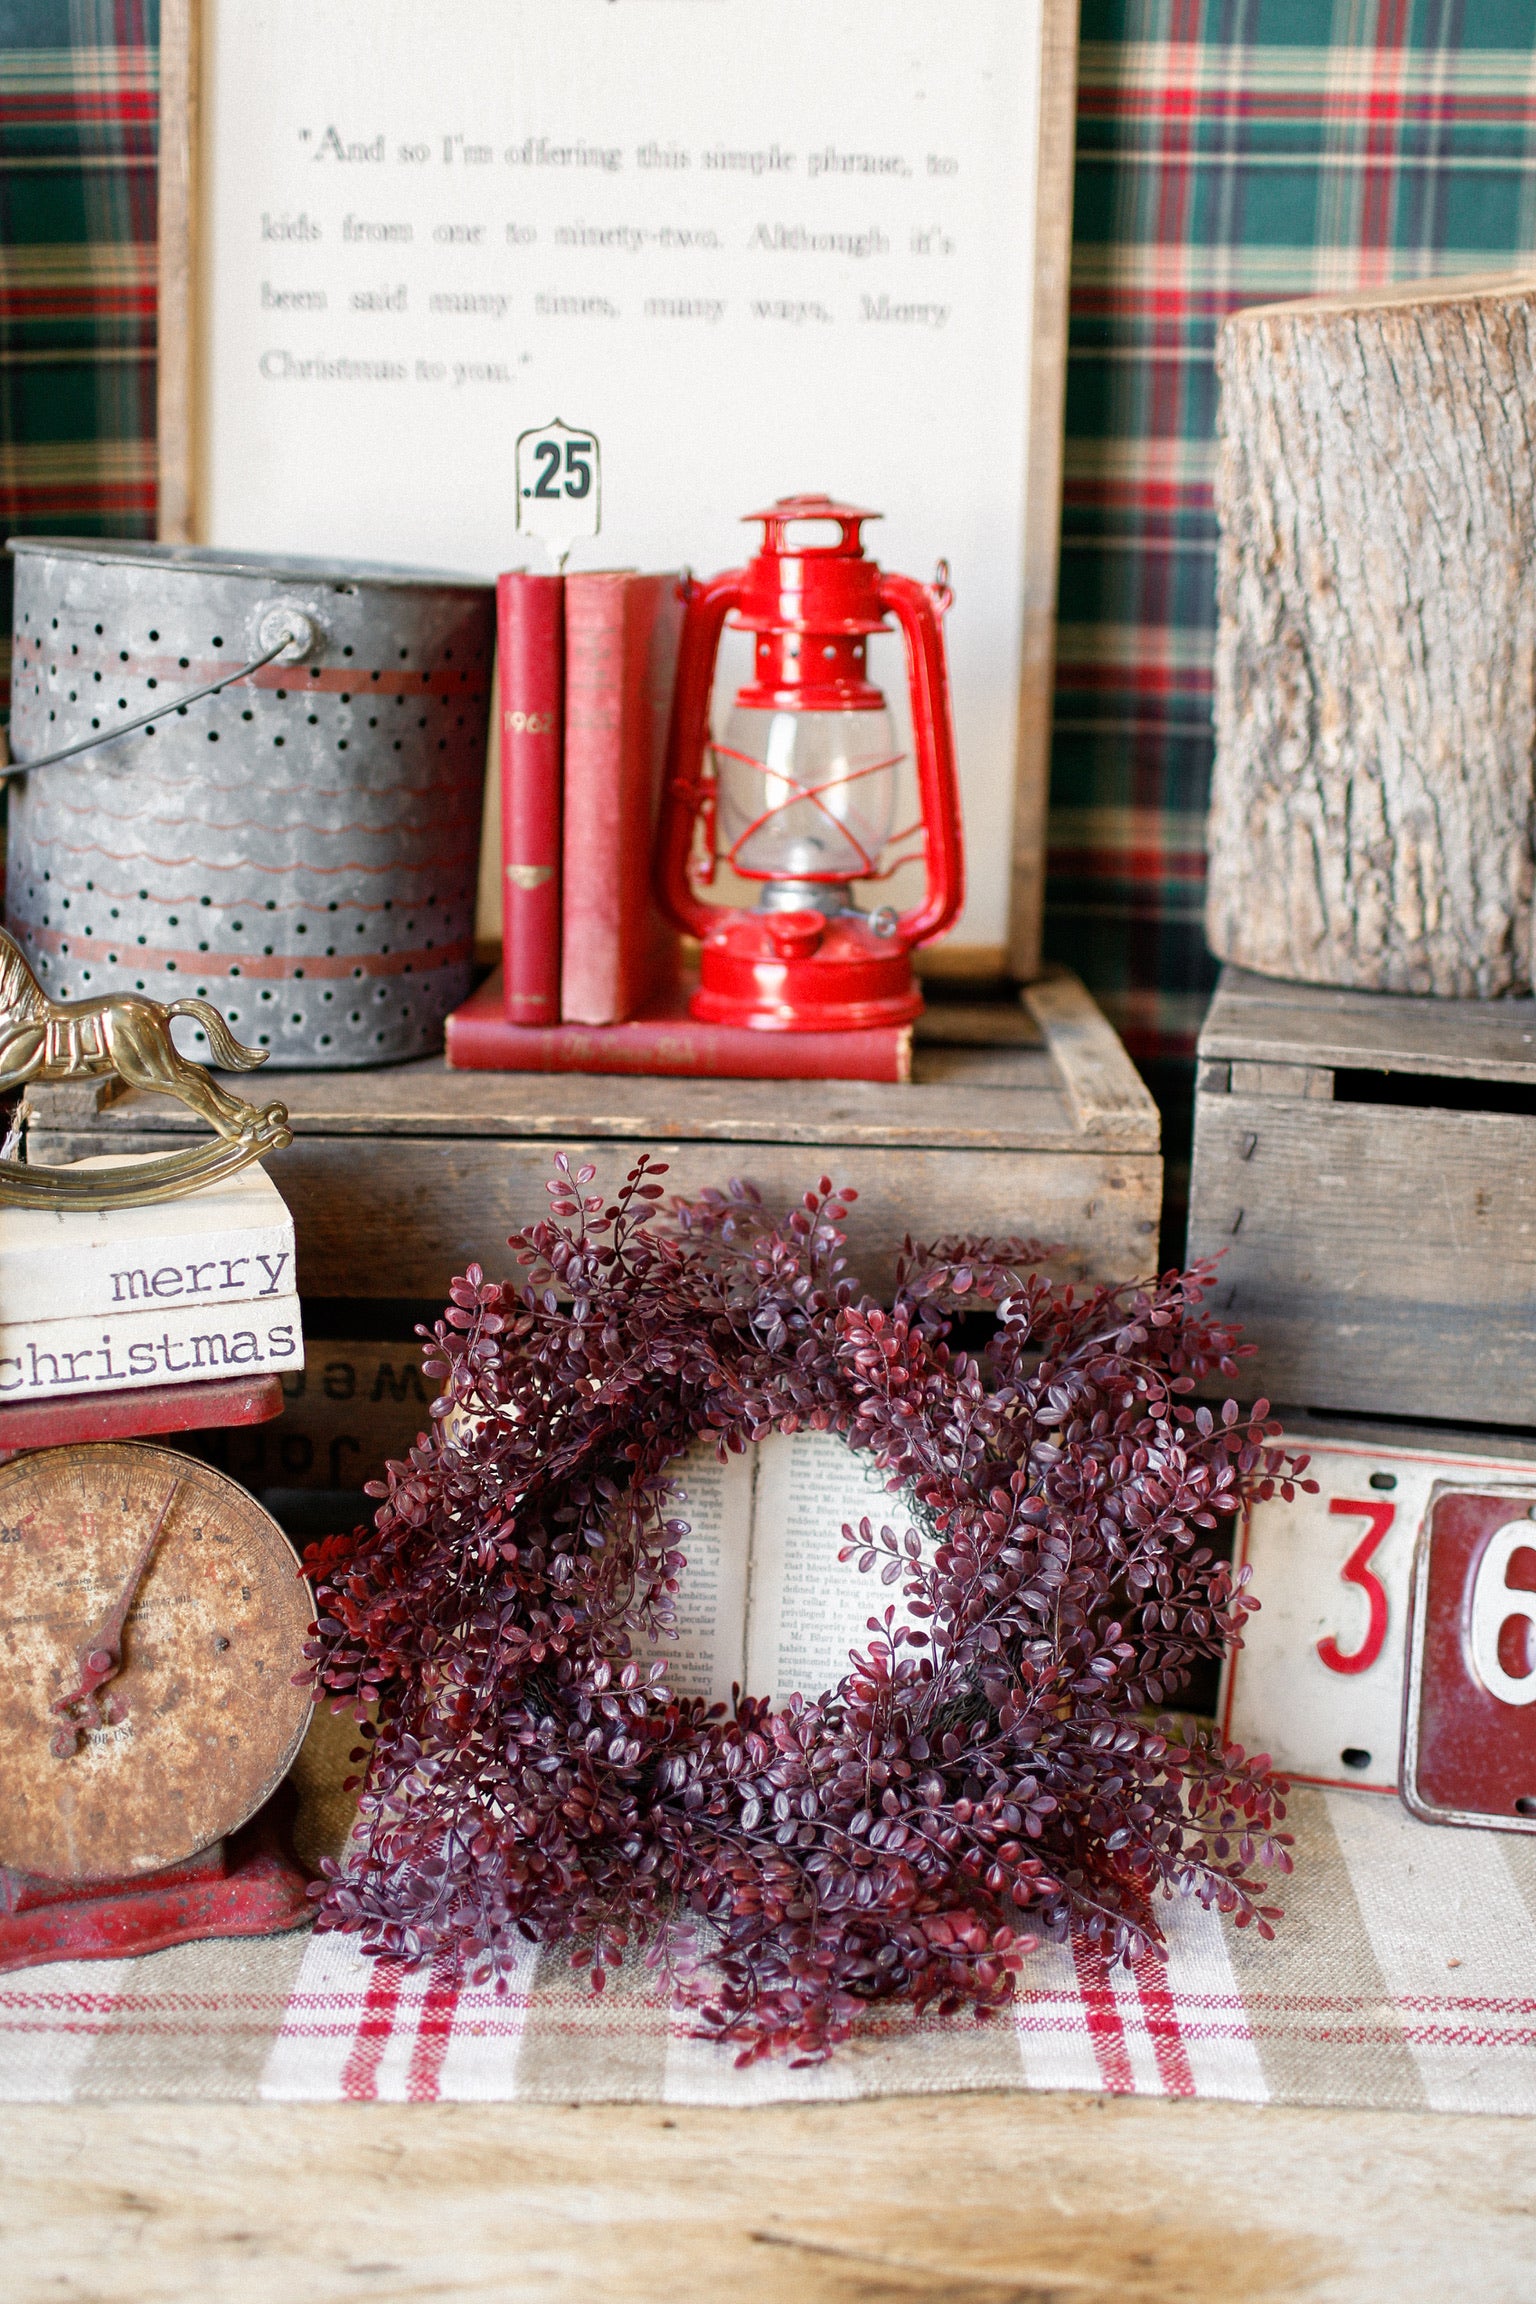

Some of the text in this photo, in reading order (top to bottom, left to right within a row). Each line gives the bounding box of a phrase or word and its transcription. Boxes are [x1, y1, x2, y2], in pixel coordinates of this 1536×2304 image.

[298, 124, 959, 179] "And so I'm offering this simple phrase, to
[260, 212, 955, 259] kids from one to ninety-two. Although it's
[260, 281, 952, 329] been said many times, many ways, Merry
[259, 348, 408, 382] Christmas
[415, 358, 447, 382] to
[522, 441, 592, 500] .25
[504, 710, 554, 736] 1962
[110, 1251, 290, 1303] merry
[0, 1323, 297, 1393] christmas
[1, 1527, 21, 1543] 23
[1316, 1497, 1397, 1676] 3
[1470, 1517, 1536, 1706] 6
[647, 1649, 681, 1658] consists
[699, 1651, 714, 1660] the
[670, 1661, 713, 1672] to whistle
[692, 1676, 713, 1685] very
